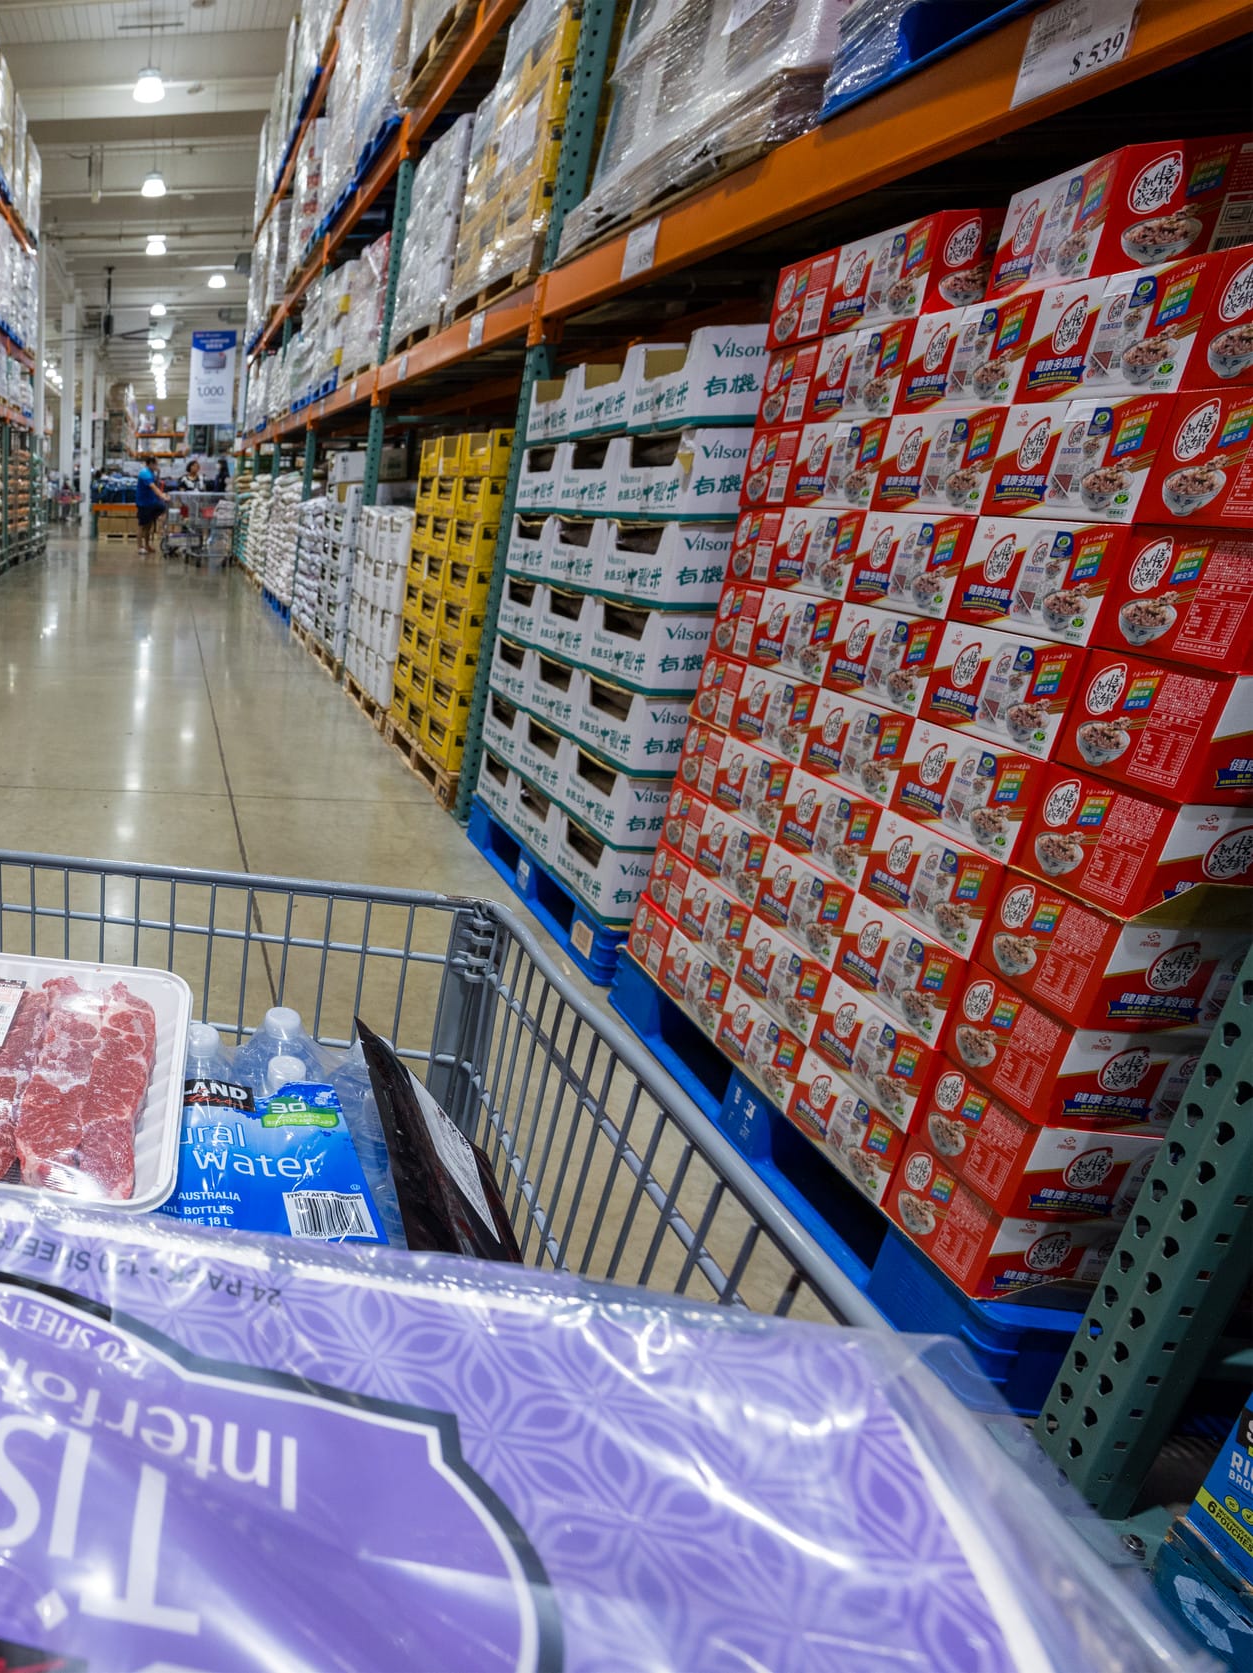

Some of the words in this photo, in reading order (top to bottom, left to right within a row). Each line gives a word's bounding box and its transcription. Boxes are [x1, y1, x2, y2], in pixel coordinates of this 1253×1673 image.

[1069, 51, 1083, 76] $
[1086, 32, 1125, 68] 539
[712, 337, 766, 358] Vilson
[1035, 356, 1082, 371] 健康多穀飯
[1001, 475, 1045, 487] 健康多穀飯
[1121, 993, 1195, 1008] 健康多穀飯
[271, 1102, 307, 1114] 30
[1075, 1094, 1144, 1108] 健康多穀飯
[192, 1150, 321, 1178] Water
[178, 1191, 241, 1202] AUSTRALIA
[1040, 1188, 1107, 1204] 健康多穀飯
[184, 1205, 235, 1215] BOTTLES
[208, 1217, 221, 1225] 18
[224, 1217, 232, 1227] L
[251, 1281, 283, 1308] 24
[96, 1339, 149, 1380] 120
[1207, 1501, 1218, 1514] 6
